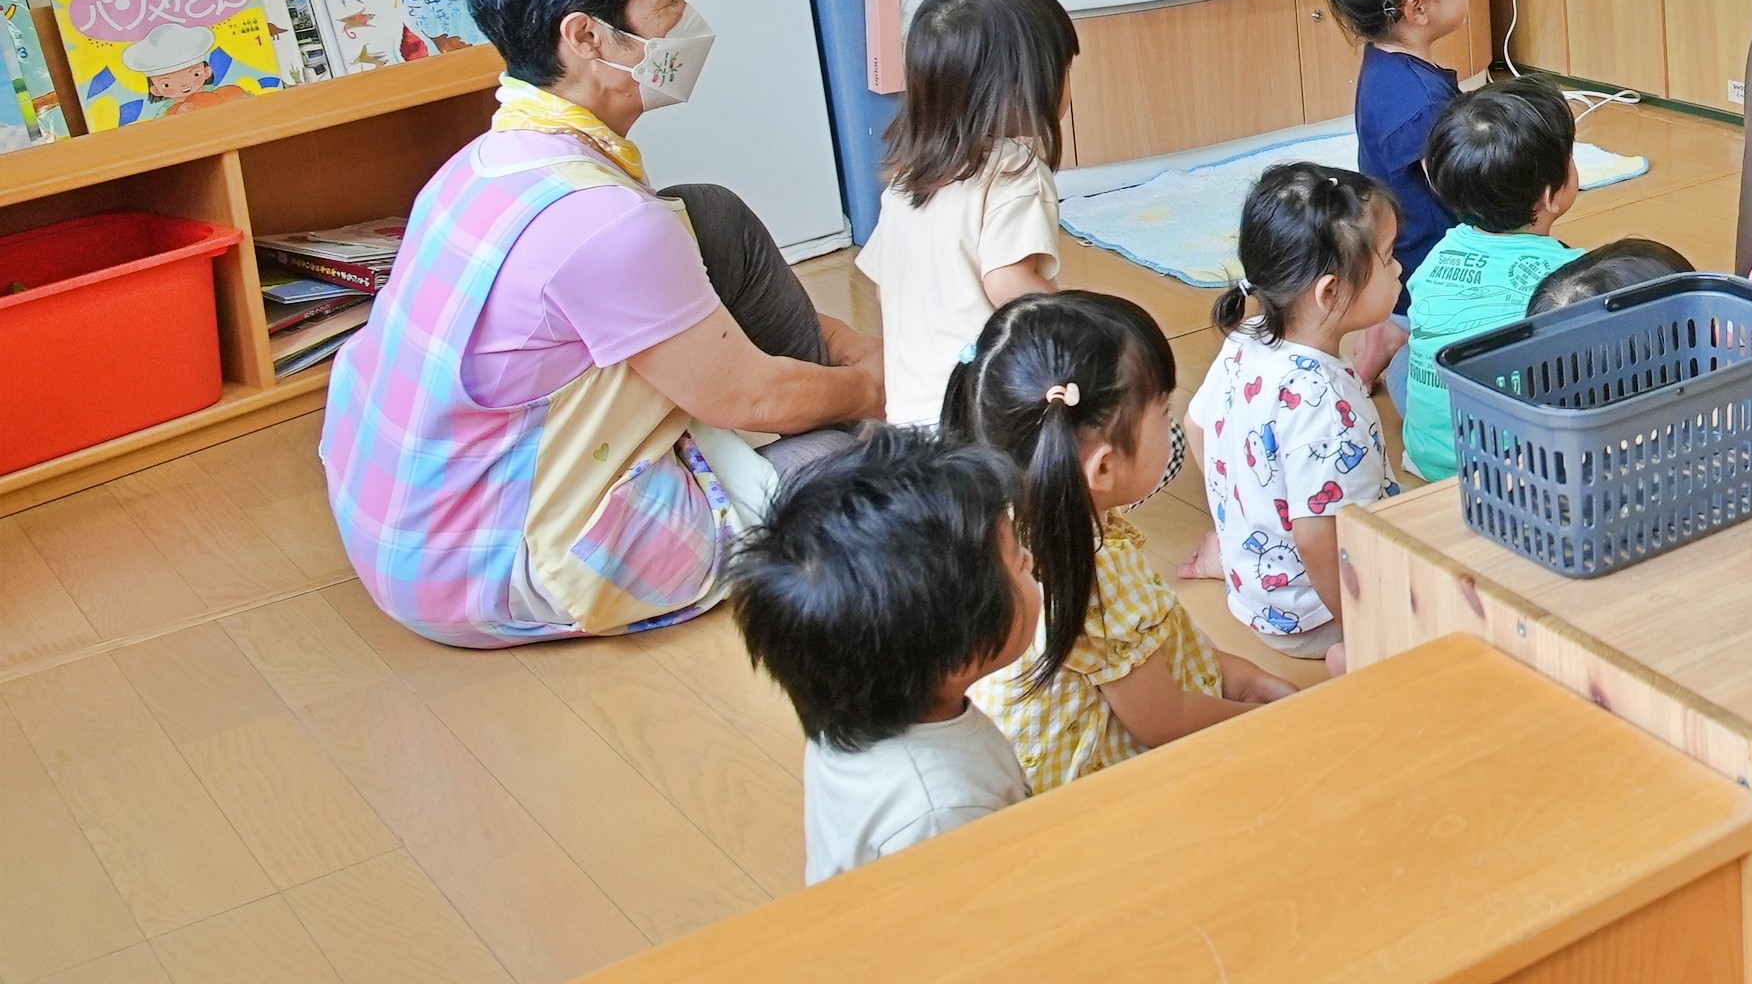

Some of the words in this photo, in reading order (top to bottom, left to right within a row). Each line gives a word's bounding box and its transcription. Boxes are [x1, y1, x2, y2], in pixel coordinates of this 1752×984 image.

[1439, 254, 1461, 266] Series
[1464, 252, 1490, 269] E5
[1429, 265, 1482, 285] HAYABUSA
